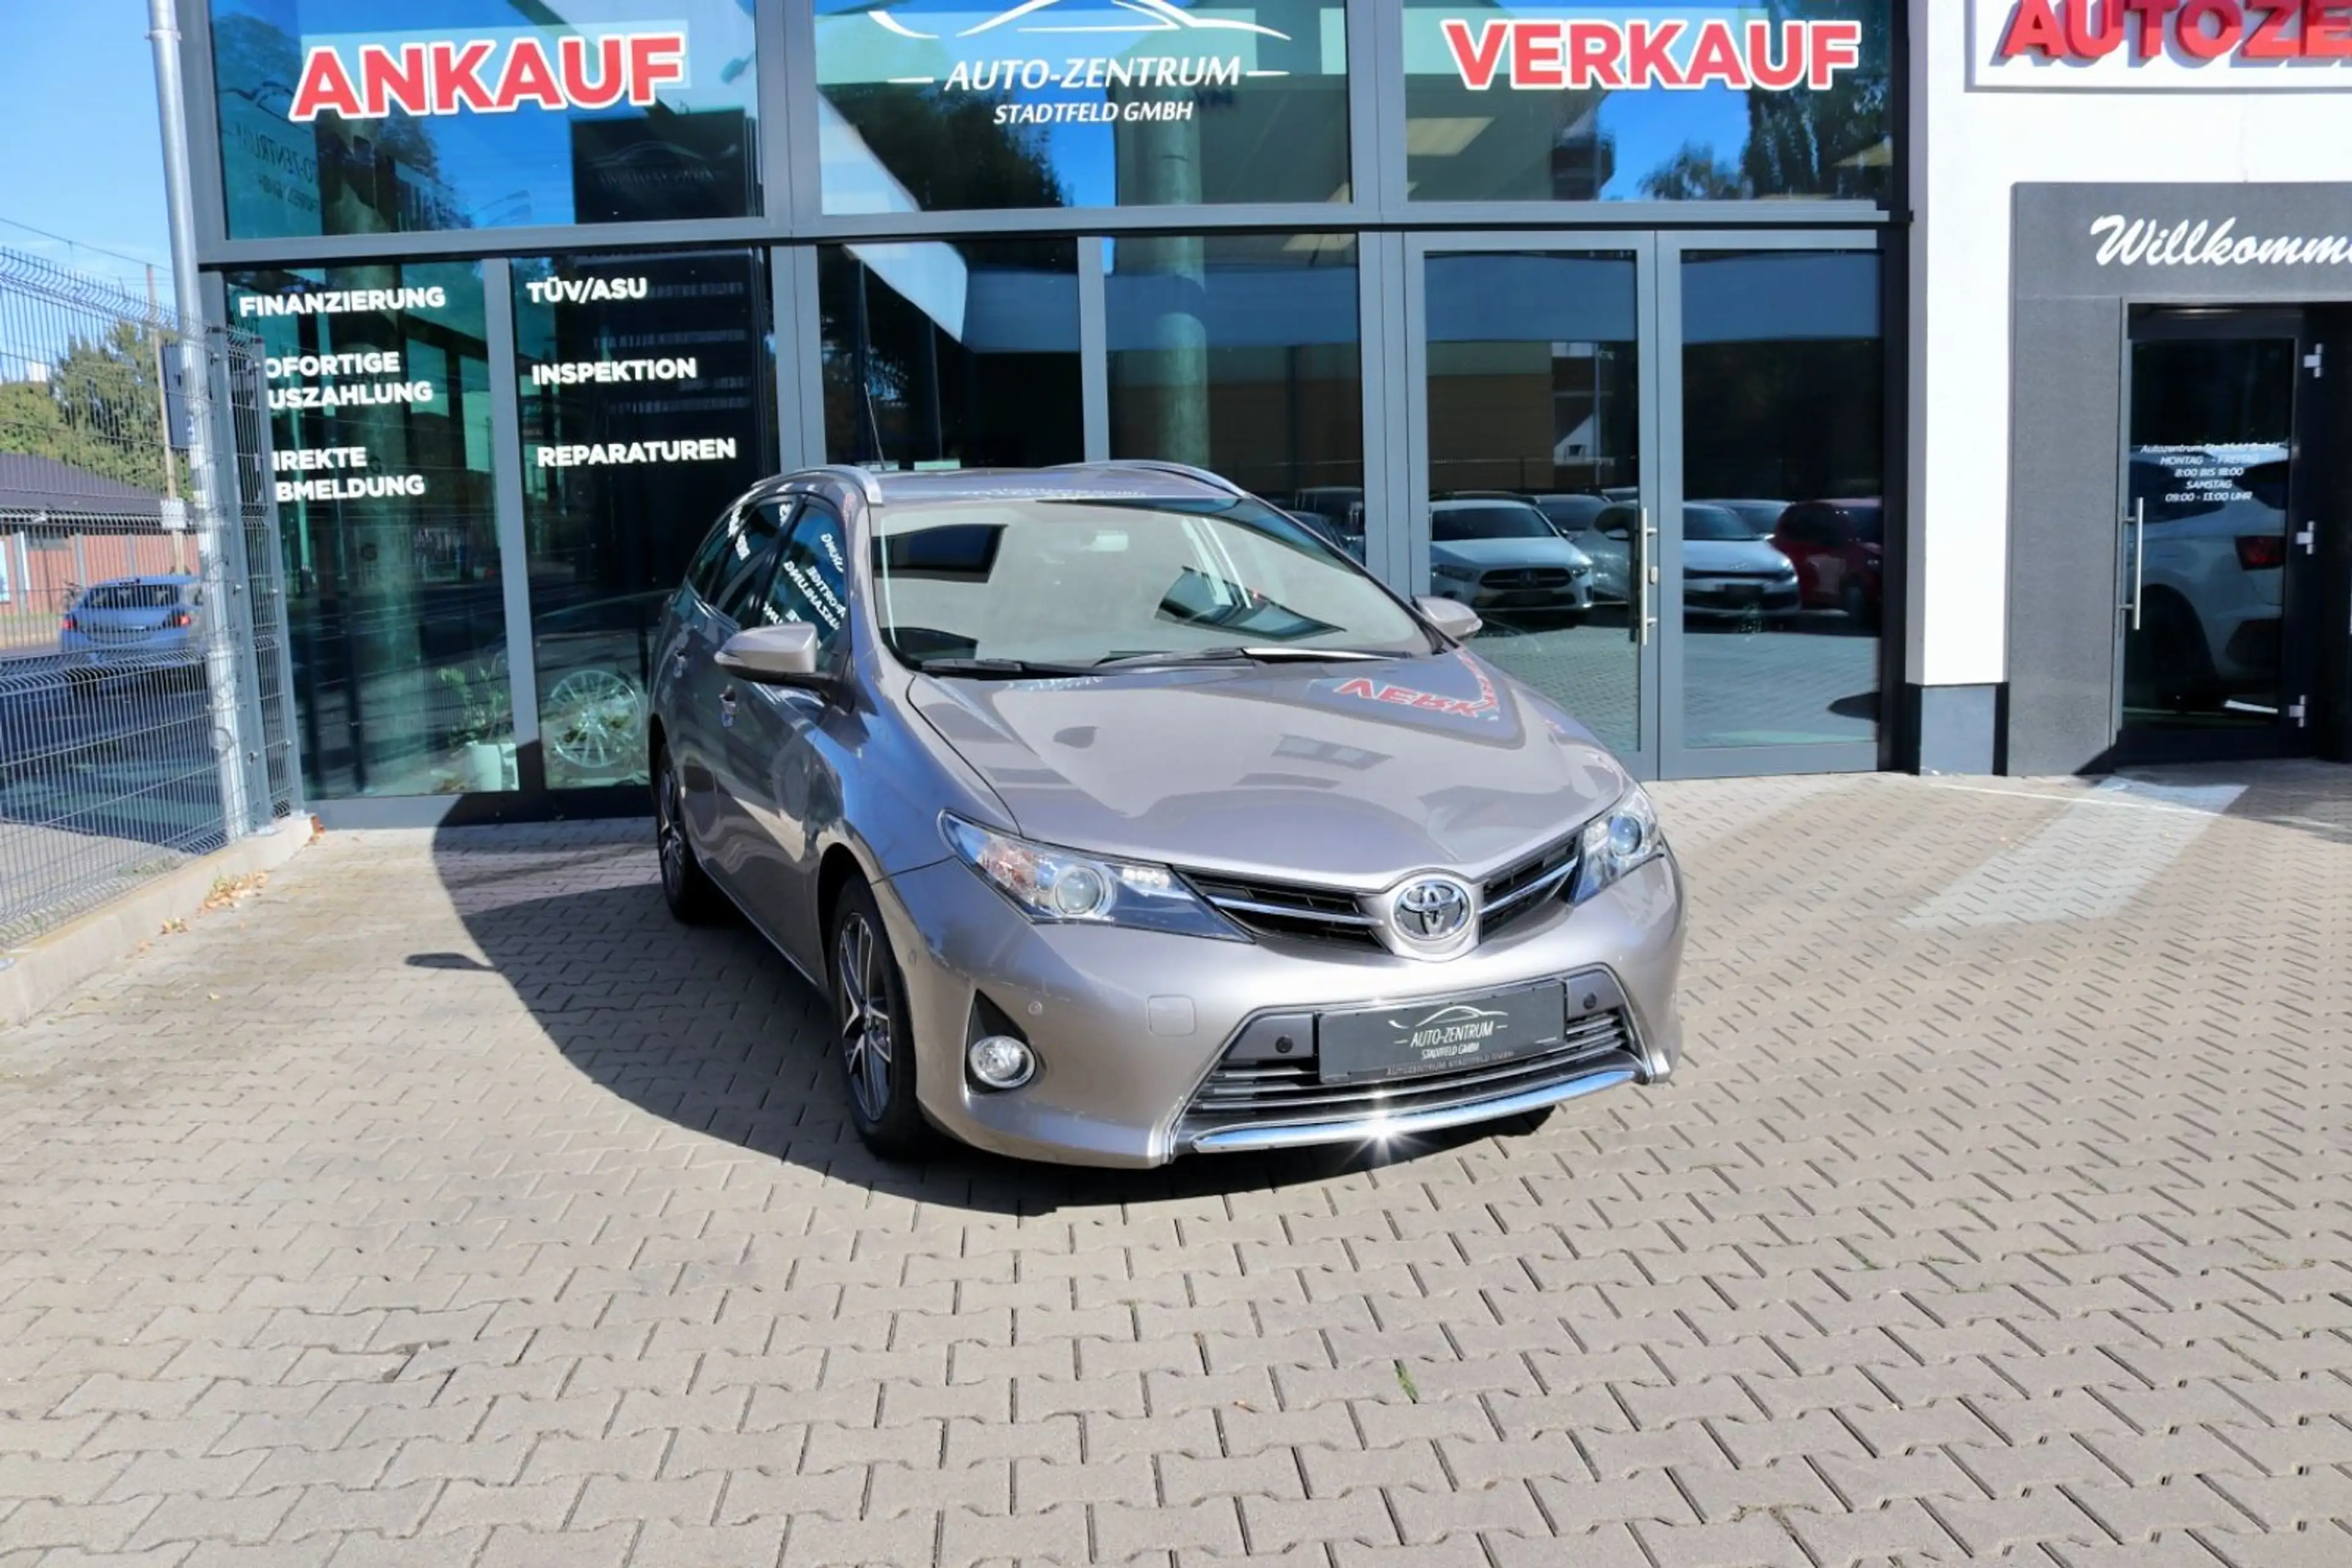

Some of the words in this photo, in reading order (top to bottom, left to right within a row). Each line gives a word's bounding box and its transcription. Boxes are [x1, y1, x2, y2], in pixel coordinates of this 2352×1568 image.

[2000, 0, 2352, 58] AUTOZE
[1441, 19, 1861, 90] VERKAUF
[288, 32, 686, 121] ANKAUF
[944, 56, 1241, 91] AUTO-ZENTRUM
[993, 102, 1118, 124] STADTFELD
[1123, 100, 1193, 121] GMBH
[2090, 214, 2352, 266] Willkomm
[239, 286, 446, 318] FINANZIERUNG
[527, 277, 648, 305] TÜV/ASU
[265, 351, 400, 379] OFORTIGE
[532, 358, 697, 385] INSPEKTION
[268, 380, 433, 410] USZAHLUNG
[271, 447, 367, 471] IREKTE
[537, 438, 736, 467] REPARATUREN
[275, 474, 425, 502] BMELDUNG
[2185, 480, 2233, 489] SAMSTAG
[1410, 1020, 1494, 1048] AUTO-ZENTRUM
